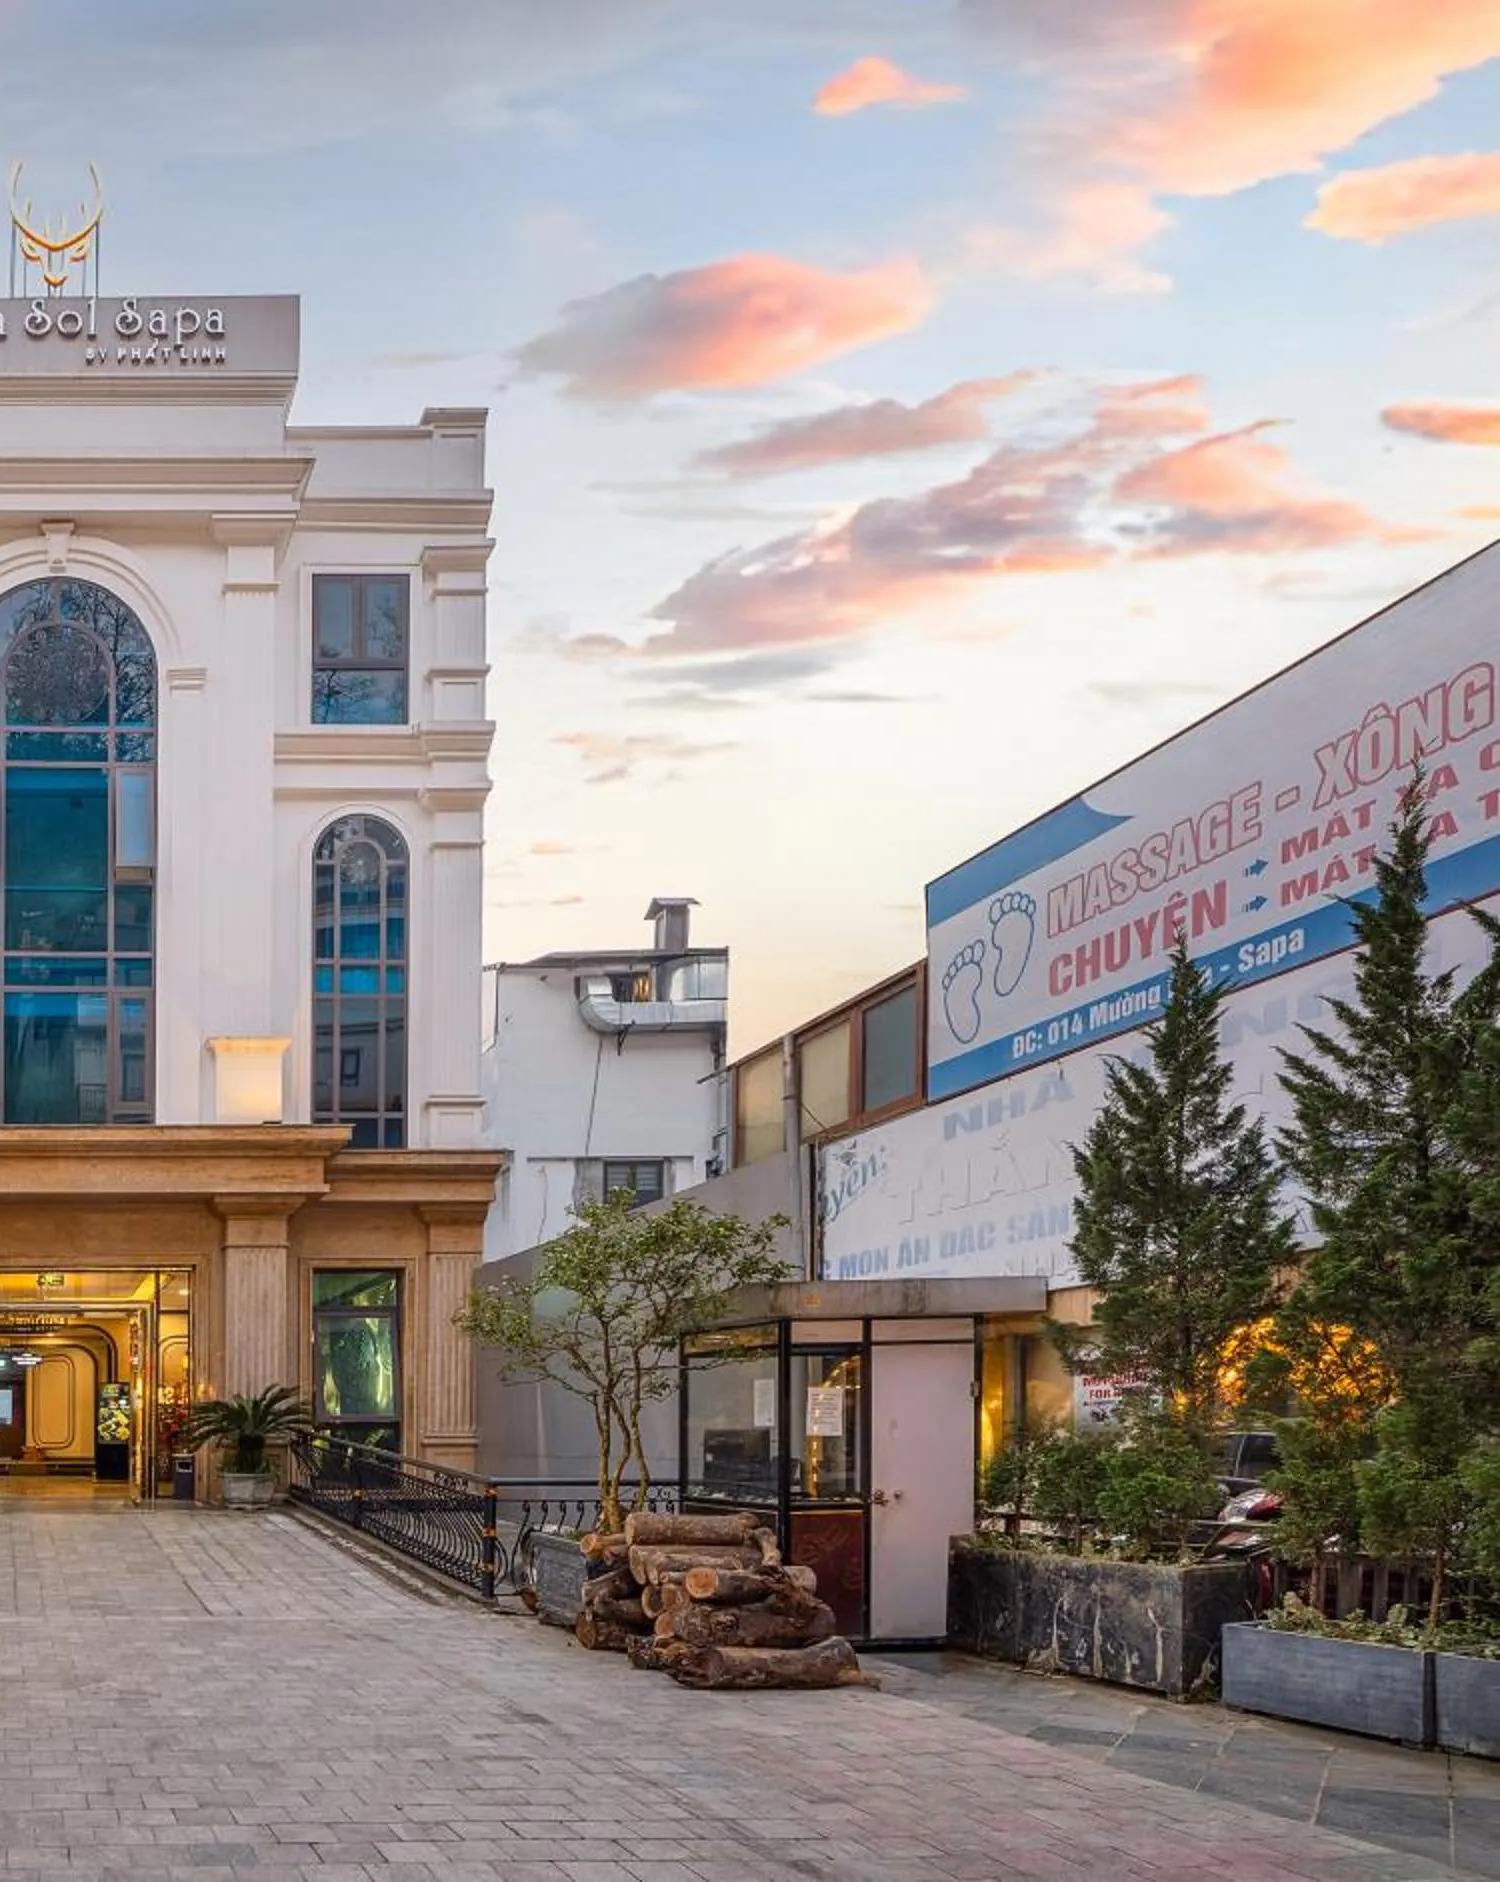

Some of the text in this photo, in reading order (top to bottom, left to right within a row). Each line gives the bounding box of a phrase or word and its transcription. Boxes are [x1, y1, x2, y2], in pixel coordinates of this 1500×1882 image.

[25, 298, 98, 337] Sol
[115, 297, 227, 347] Sapa
[85, 347, 107, 360] BY
[179, 347, 226, 360] LINH
[1046, 780, 1263, 939] MASSAGE
[1312, 661, 1495, 811] XÔNG
[1280, 800, 1377, 865] MÁT
[1280, 844, 1377, 908] MÁT
[1048, 879, 1228, 997] CHUYÊN
[1048, 1016, 1084, 1046] 014
[1237, 928, 1306, 974] Sapa
